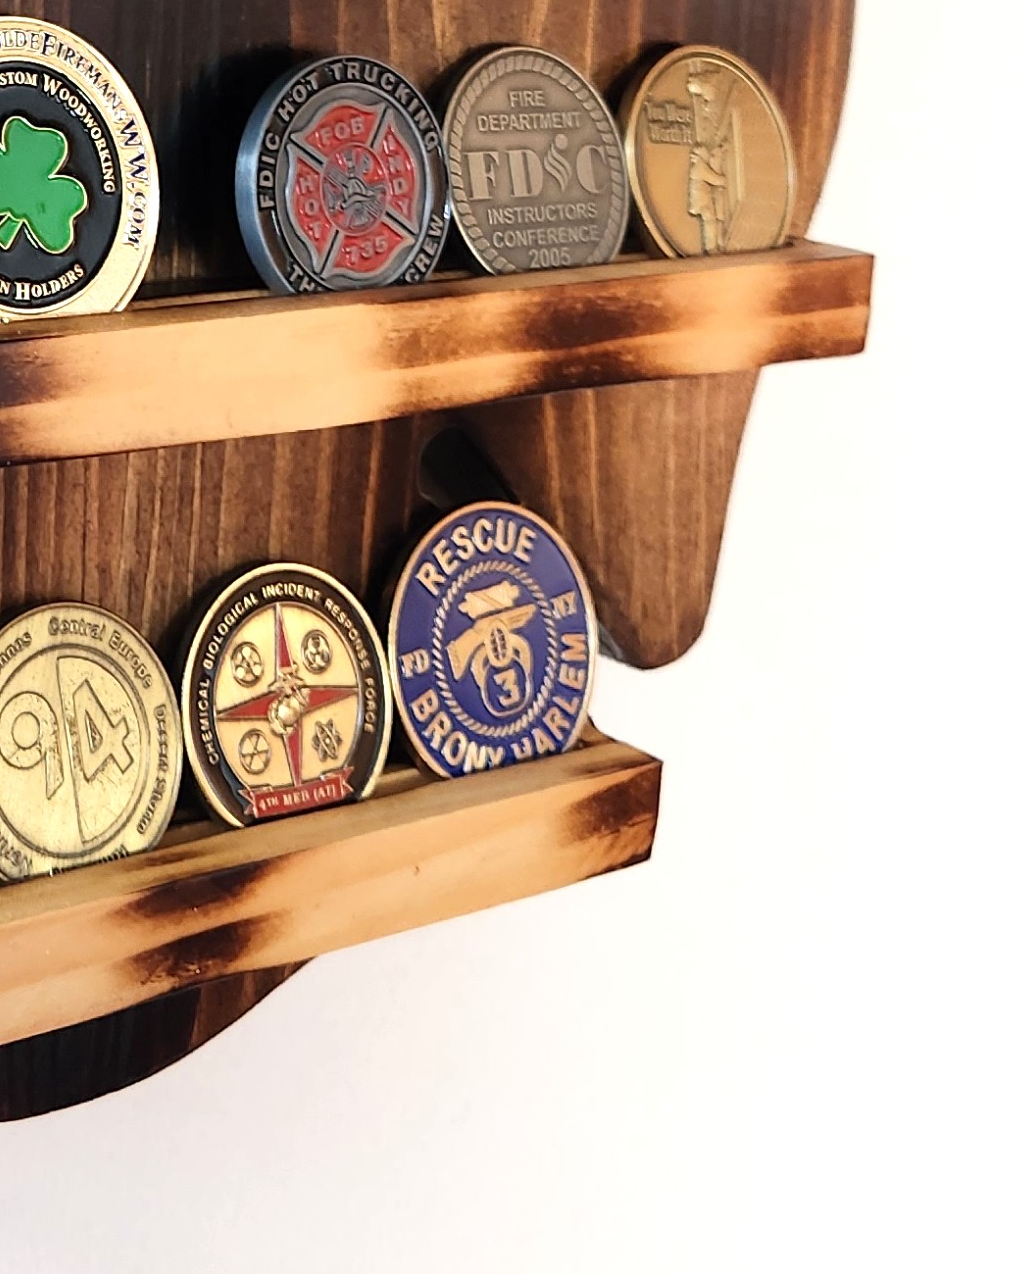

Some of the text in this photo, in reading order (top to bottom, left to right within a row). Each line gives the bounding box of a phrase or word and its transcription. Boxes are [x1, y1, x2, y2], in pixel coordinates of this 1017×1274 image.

[508, 90, 546, 108] FIRE
[42, 73, 116, 194] WOODWORKING
[258, 59, 440, 210] FDIC HOT TRUCKING
[477, 110, 582, 132] DEPARTMENT
[487, 202, 599, 225] INSTRUCTORS
[404, 213, 446, 283] CREW
[492, 226, 600, 249] CONFERENCE
[528, 246, 571, 269] 2005
[14, 263, 85, 301] HOLDERS
[287, 265, 324, 293] TH
[415, 517, 537, 597] RESCUE
[48, 615, 154, 691] Central Europe
[399, 648, 430, 679] FD
[197, 582, 378, 766] CHEMICAL BIOLOGICAL INCIDENT RESPONSE FORCE
[493, 668, 521, 708] 3
